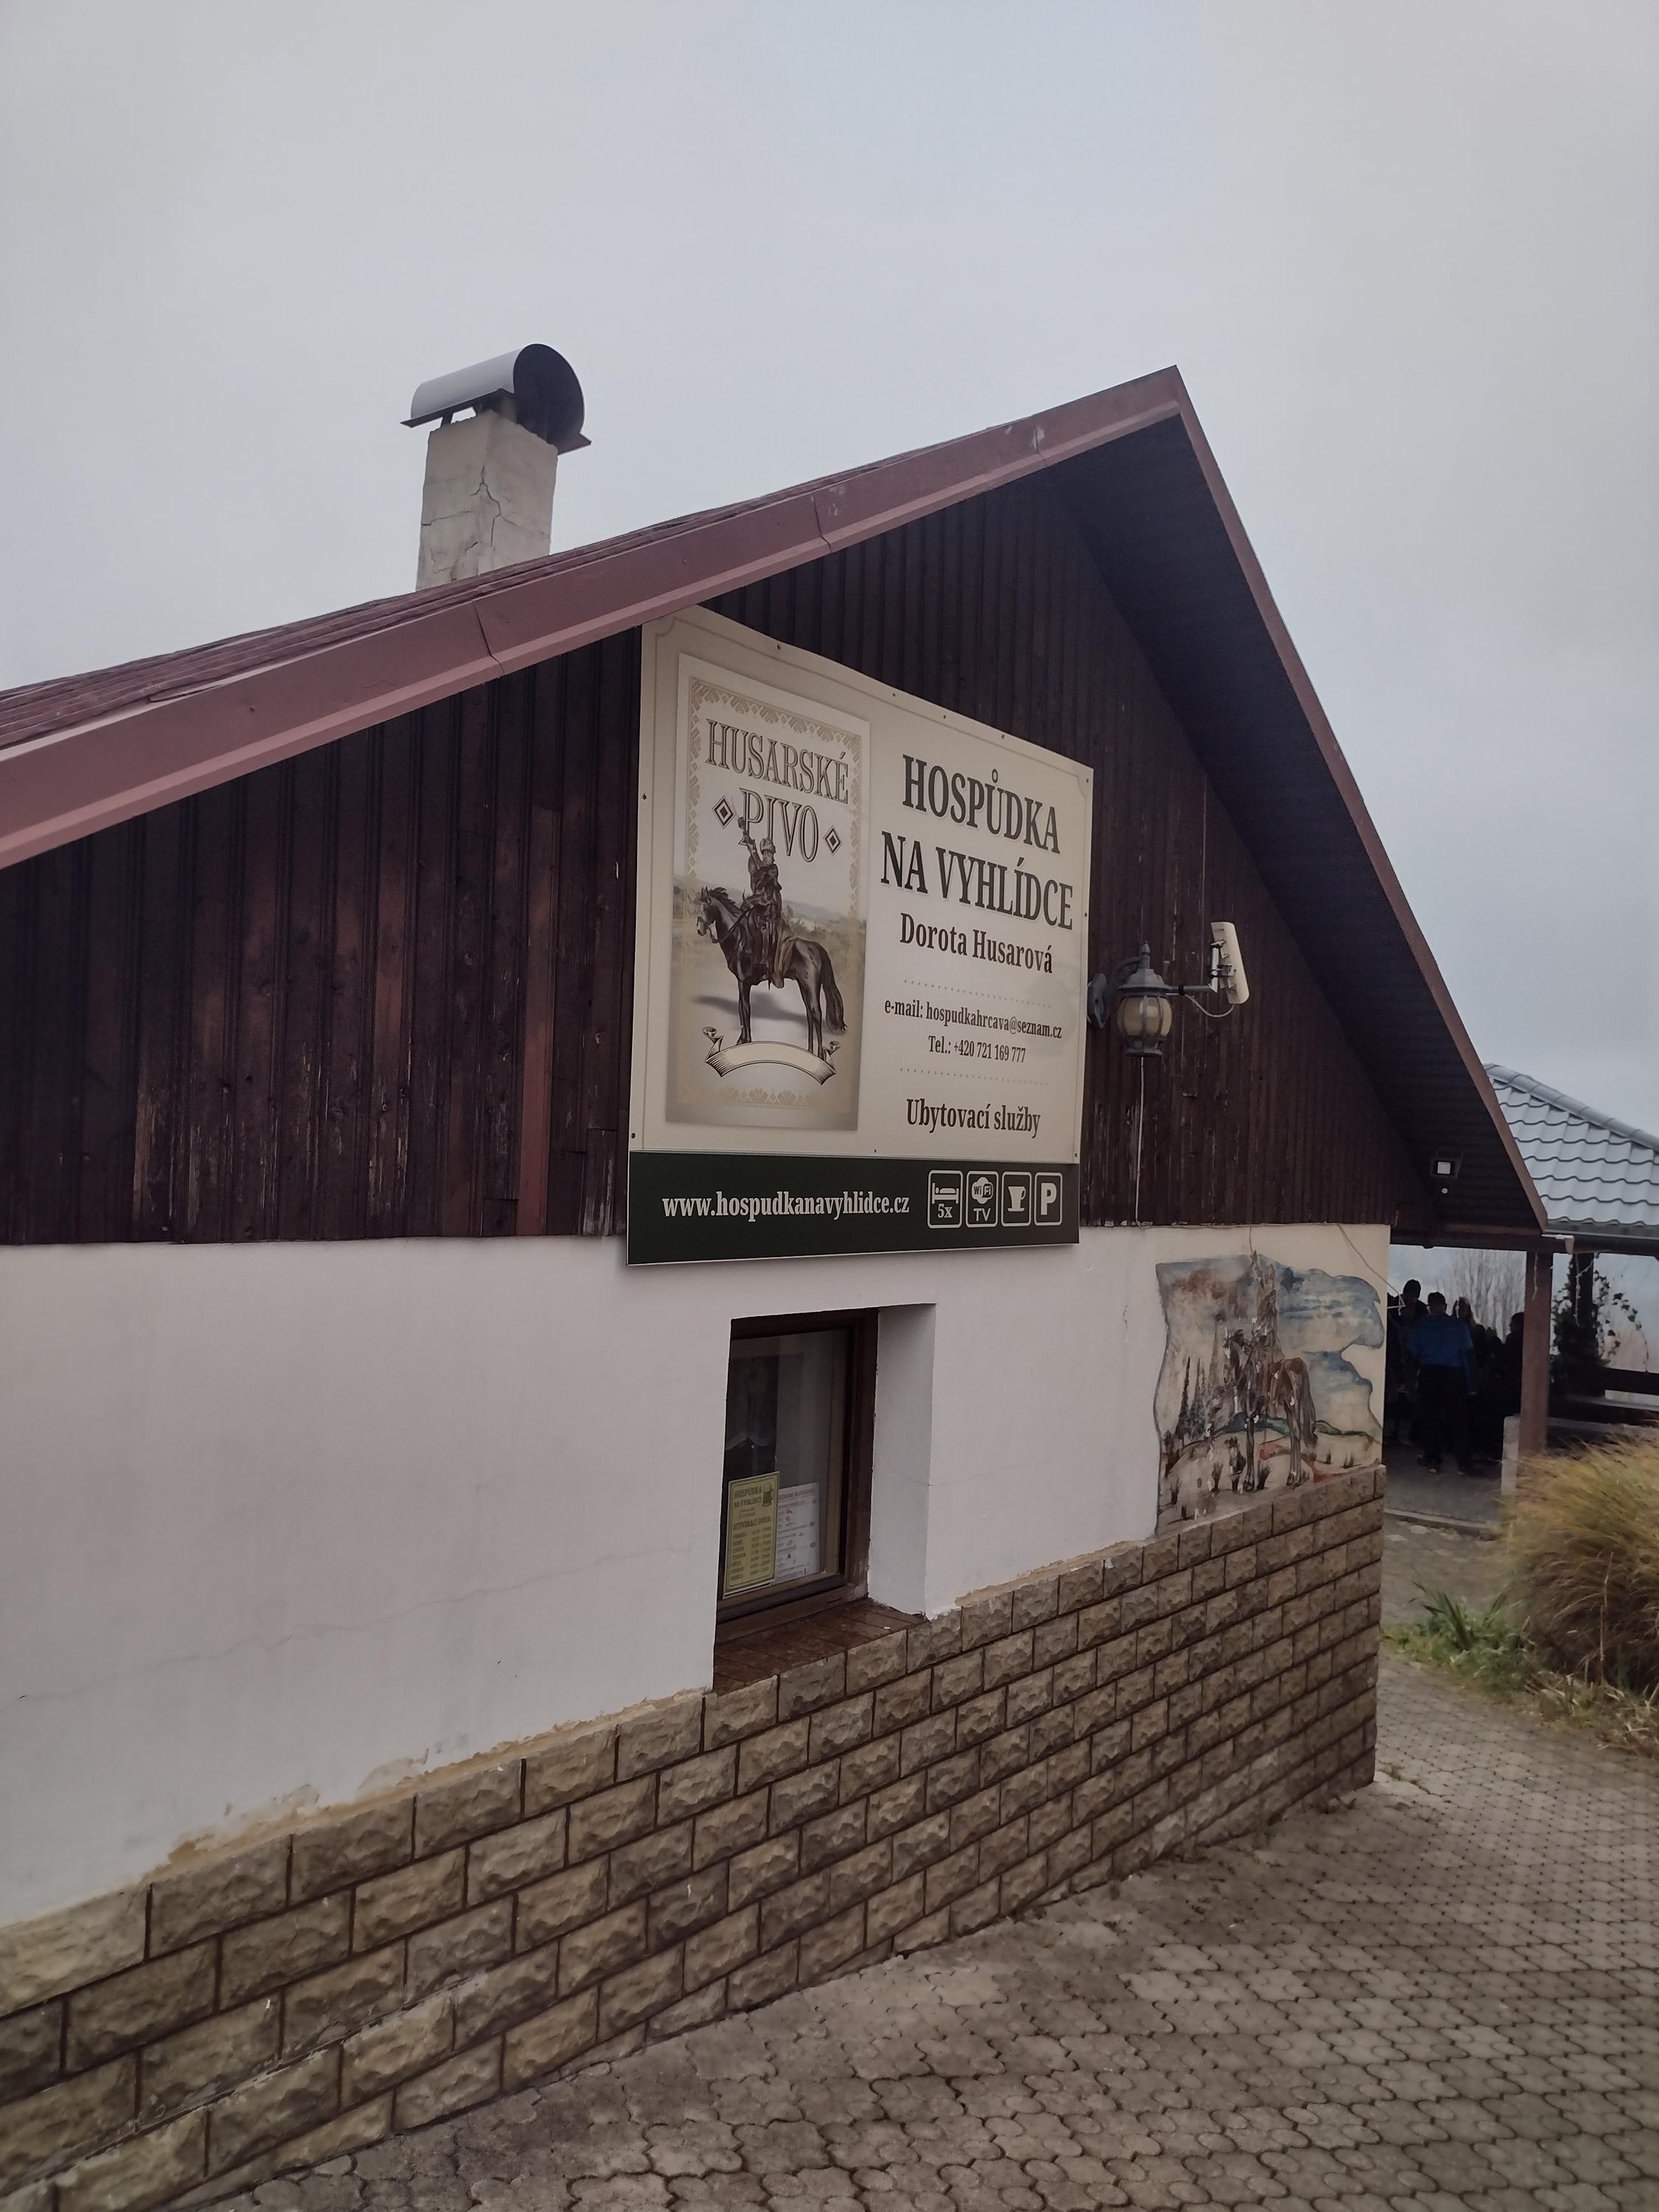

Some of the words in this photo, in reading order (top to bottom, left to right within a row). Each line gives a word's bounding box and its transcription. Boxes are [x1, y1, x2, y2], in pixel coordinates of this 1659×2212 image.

[705, 718, 848, 804] HUSARSKÉ
[902, 754, 1060, 854] HOSPŮDKA
[738, 787, 819, 862] PIVO
[880, 830, 928, 894] NA
[936, 846, 1073, 930] VYHLÍDCE
[900, 913, 967, 956] Dorota
[973, 929, 1053, 973] Husarová
[885, 999, 923, 1018] e-mail:
[925, 1002, 1062, 1039] hospudkahrcava@seznam.cz
[928, 1035, 951, 1054] Tel.:
[953, 1039, 975, 1057] +420
[977, 1042, 992, 1059] 721
[995, 1044, 1009, 1061] 169
[1012, 1046, 1026, 1063] 777
[906, 1098, 990, 1133] Ubytovací
[994, 1105, 1041, 1138] služby
[662, 1192, 910, 1222] www.hospudkanavyhlidce.cz
[937, 1203, 953, 1218] 5x
[973, 1208, 991, 1222] TV
[1040, 1183, 1057, 1215] P
